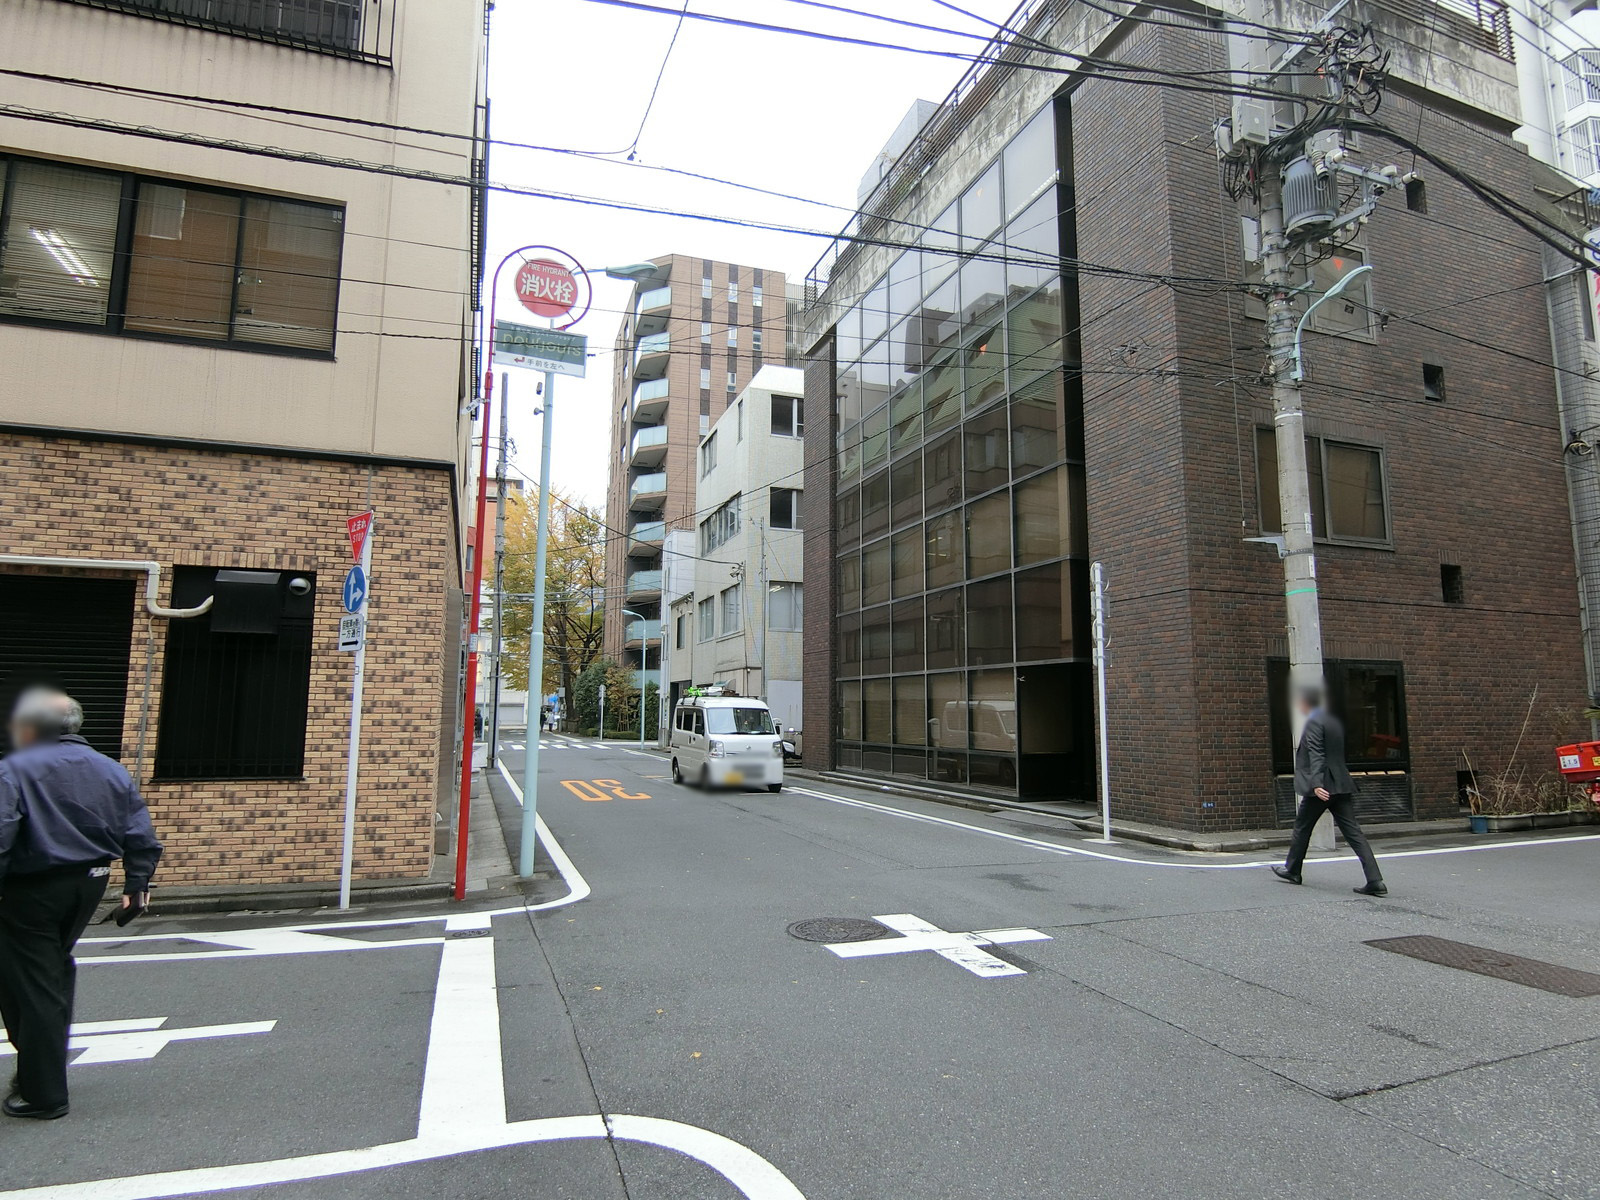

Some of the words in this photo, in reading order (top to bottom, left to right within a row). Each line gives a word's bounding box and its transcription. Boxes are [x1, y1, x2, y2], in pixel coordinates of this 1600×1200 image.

[527, 263, 541, 272] FIRE
[542, 265, 570, 277] HYDRANT
[520, 272, 574, 304] 消火栓
[527, 358, 565, 371] 手前を左へ
[351, 518, 367, 533] 止まれ
[352, 532, 364, 543] STOP
[341, 628, 361, 639] 一方通行
[559, 779, 653, 802] 30
